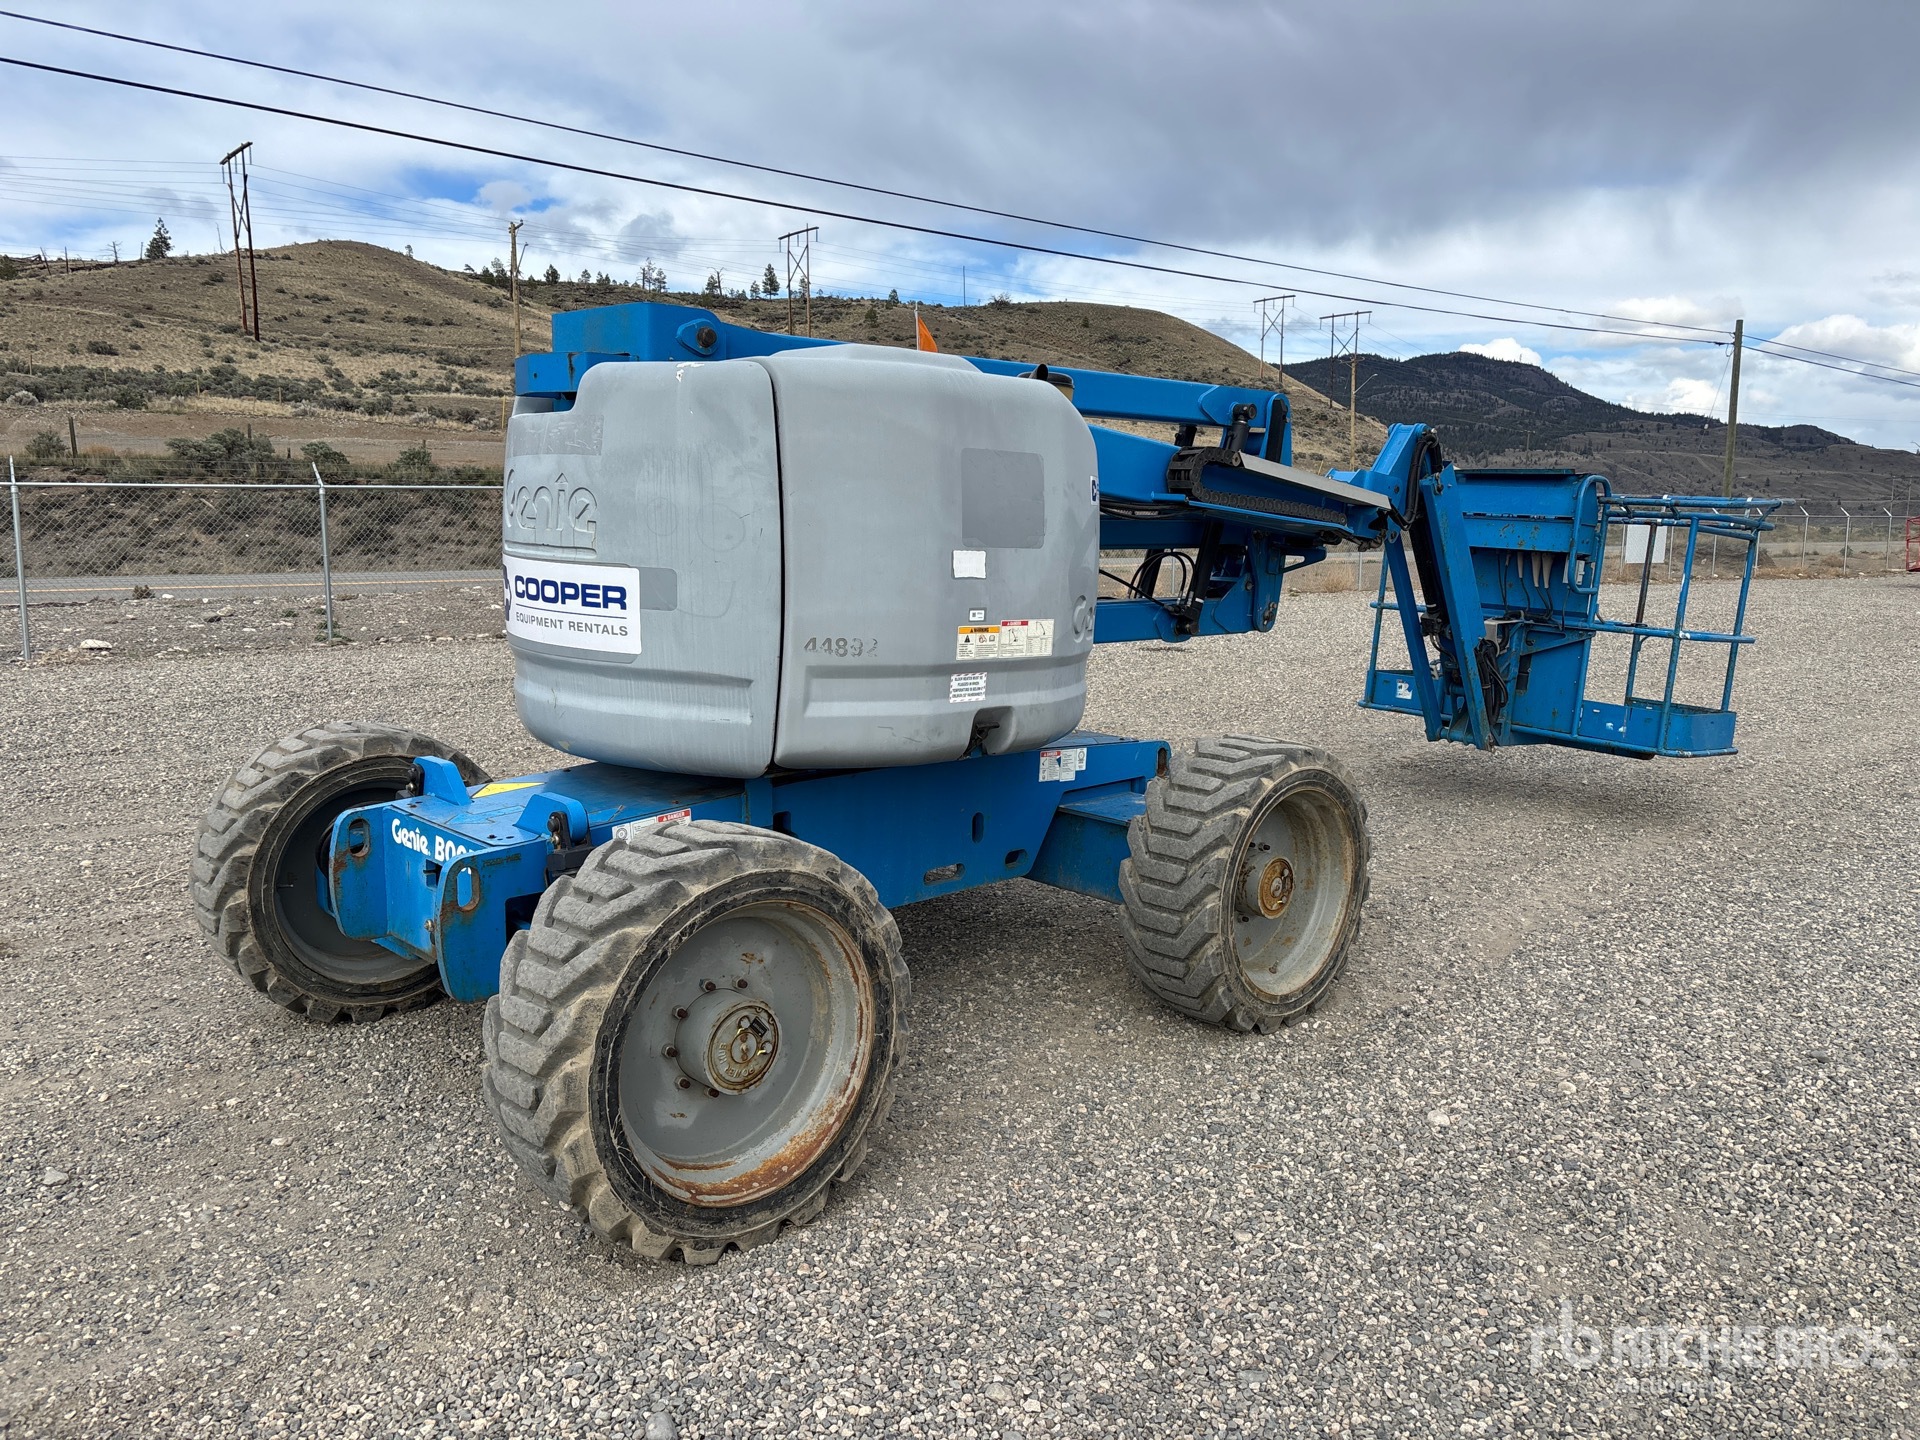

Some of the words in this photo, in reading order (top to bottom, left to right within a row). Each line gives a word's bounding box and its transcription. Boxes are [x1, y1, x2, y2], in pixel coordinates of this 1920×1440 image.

[515, 575, 627, 610] COOPER
[516, 612, 564, 629] EQUIPMENT
[568, 620, 629, 637] RENTALS
[667, 811, 686, 820] DANGER
[392, 818, 429, 856] Genie
[434, 835, 475, 867] BOO
